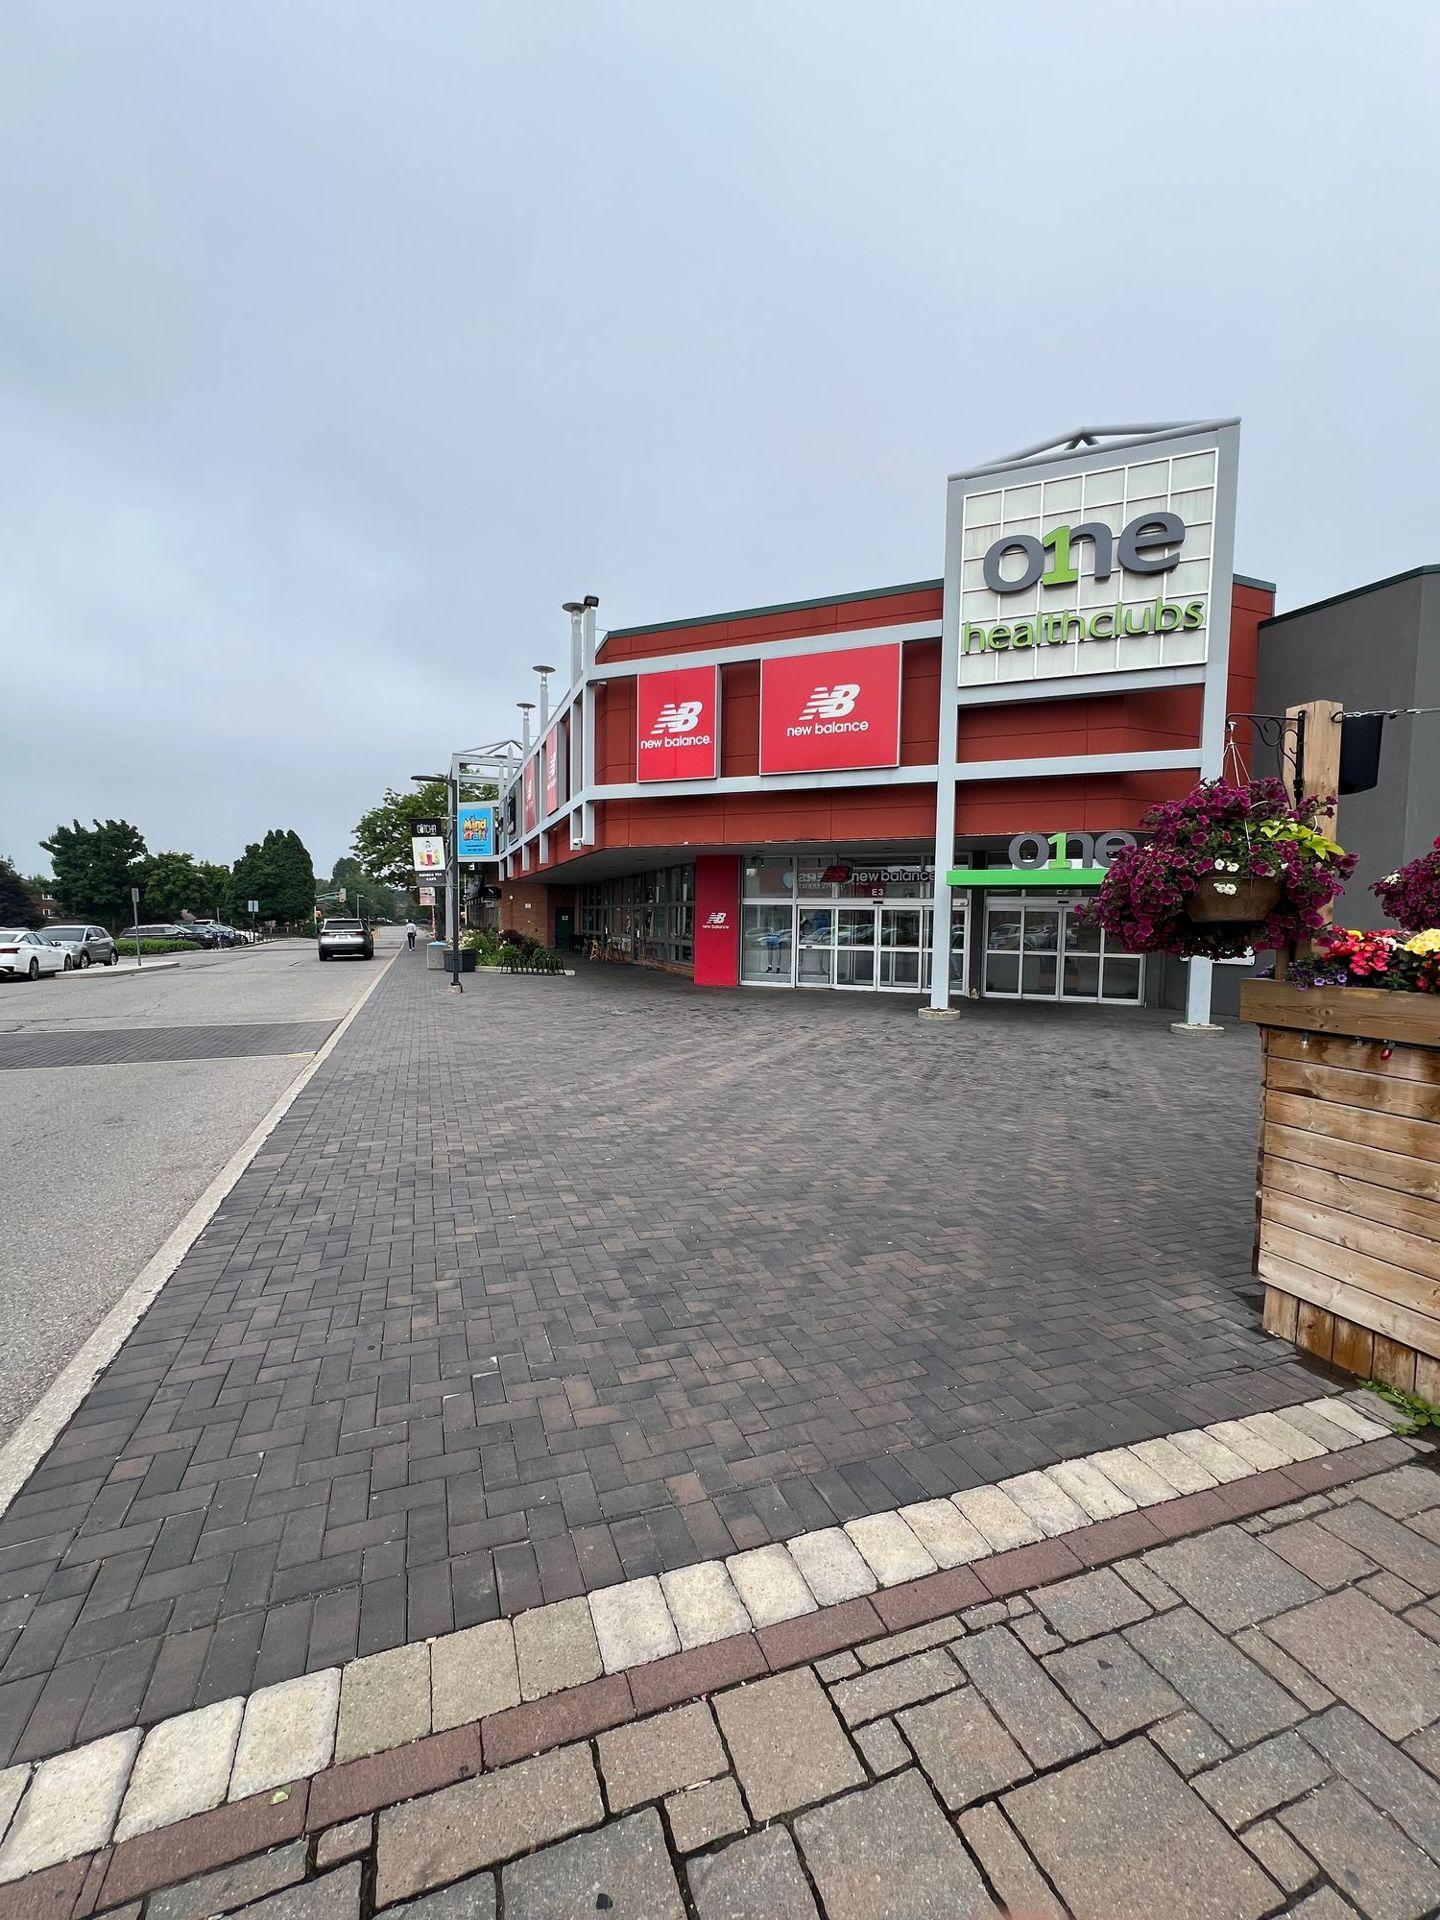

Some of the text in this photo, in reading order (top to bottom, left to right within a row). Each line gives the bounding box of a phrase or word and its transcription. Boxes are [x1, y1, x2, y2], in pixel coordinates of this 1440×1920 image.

[798, 683, 860, 721] NB
[650, 701, 703, 735] NB
[786, 719, 869, 737] new balance
[640, 734, 711, 750] new balance
[852, 871, 880, 882] new
[871, 888, 884, 896] E3
